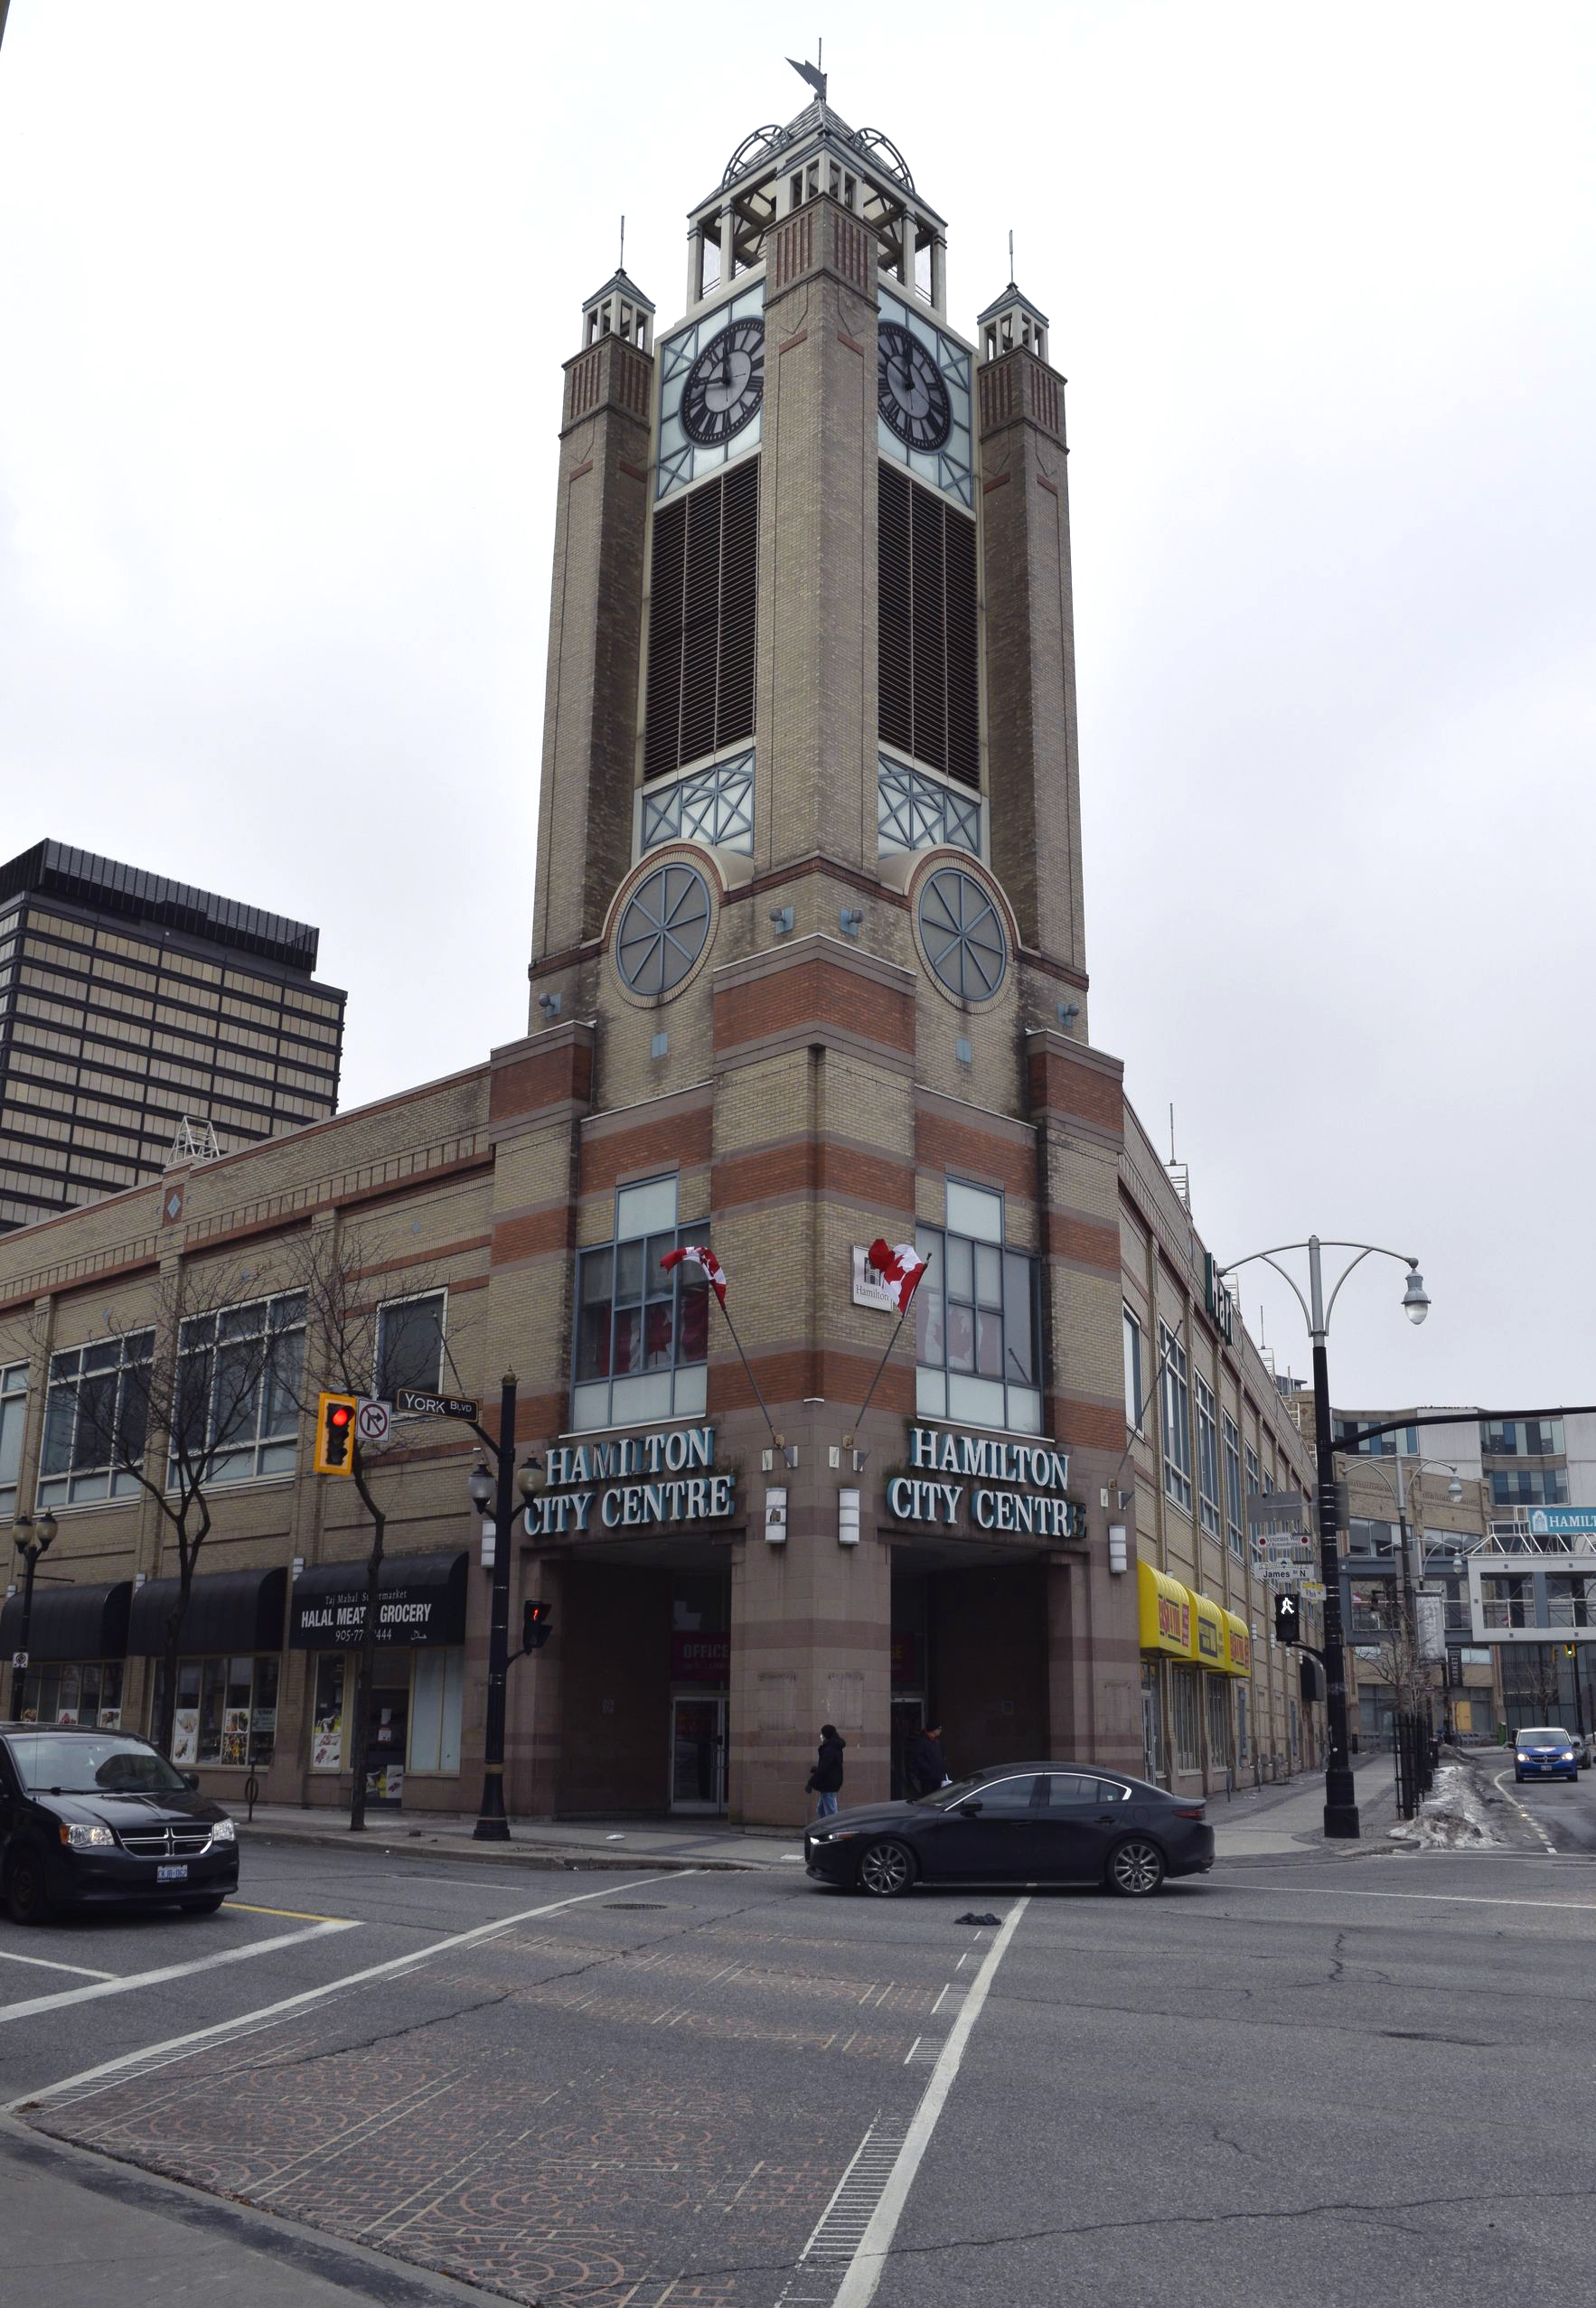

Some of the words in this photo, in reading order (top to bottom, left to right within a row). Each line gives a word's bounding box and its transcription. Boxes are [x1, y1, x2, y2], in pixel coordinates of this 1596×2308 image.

[856, 1284, 889, 1301] Hamilton
[404, 1393, 446, 1414] YORK
[545, 1427, 716, 1487] HAMILTON
[910, 1427, 1070, 1490] HAMILTON
[524, 1492, 596, 1536] CITY
[601, 1474, 736, 1527] CENTRE
[887, 1477, 963, 1524] CITY
[972, 1488, 1087, 1539] CENTRE
[1263, 1570, 1291, 1578] James
[337, 1592, 358, 1605] Mahal
[301, 1608, 333, 1628] HALAL
[380, 1603, 431, 1623] GROCERY
